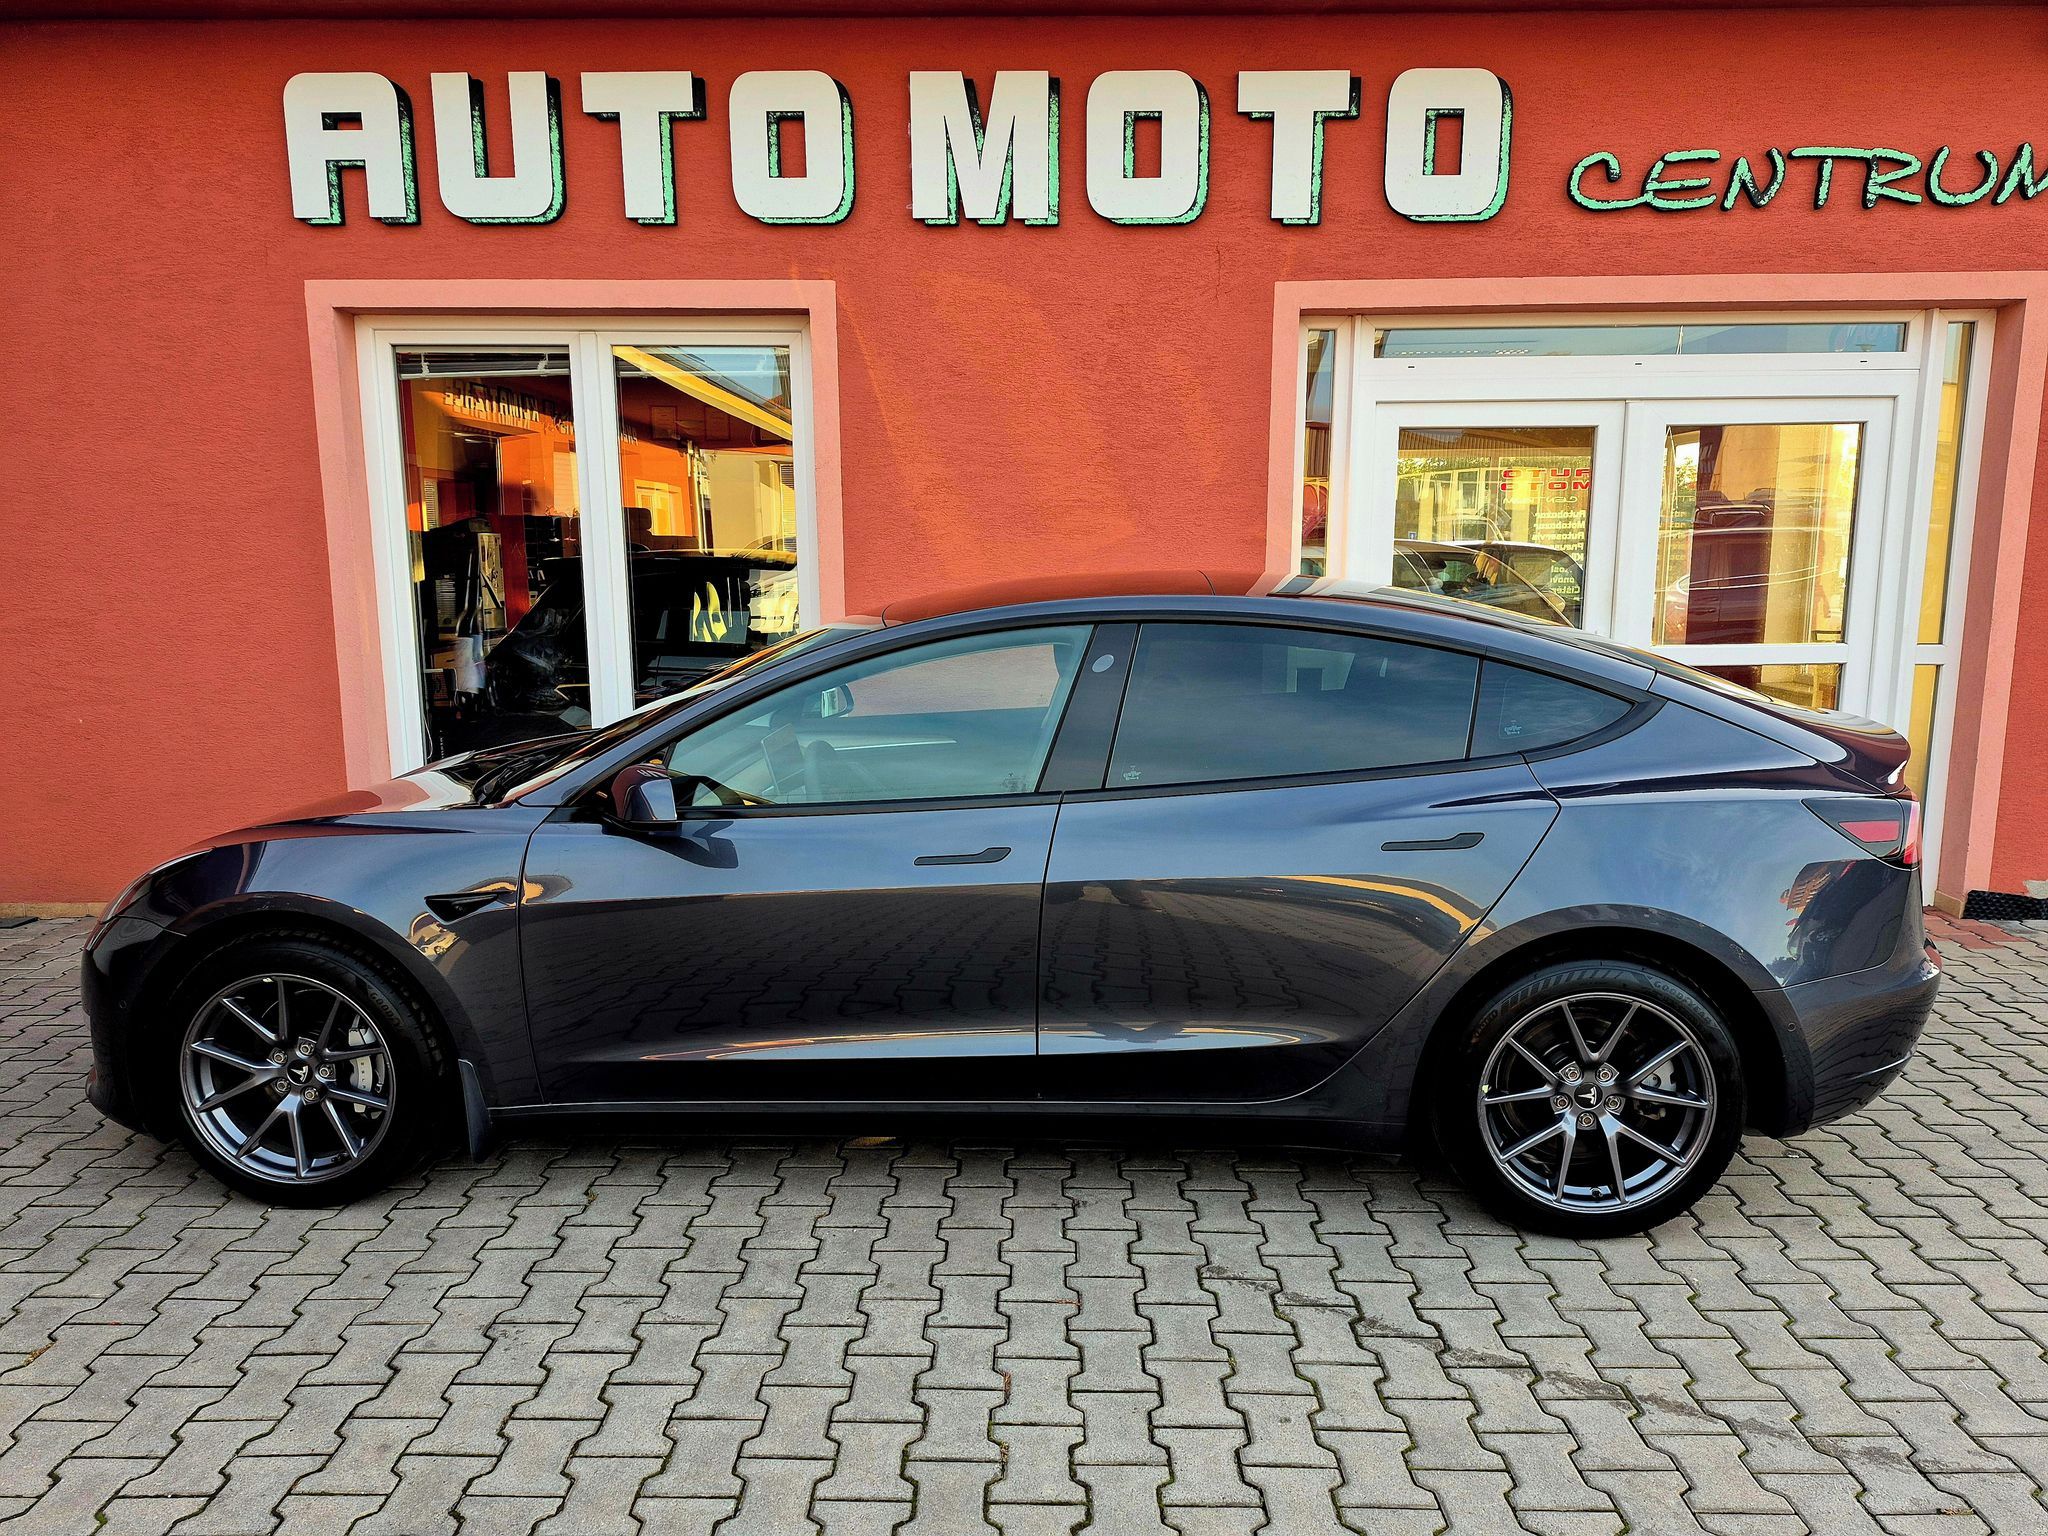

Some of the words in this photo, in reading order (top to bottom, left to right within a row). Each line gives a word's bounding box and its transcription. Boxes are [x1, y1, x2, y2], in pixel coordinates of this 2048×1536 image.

[283, 70, 855, 226] AUTO
[909, 68, 1513, 226] MOTO
[1654, 981, 1712, 1024] GOODYEAR
